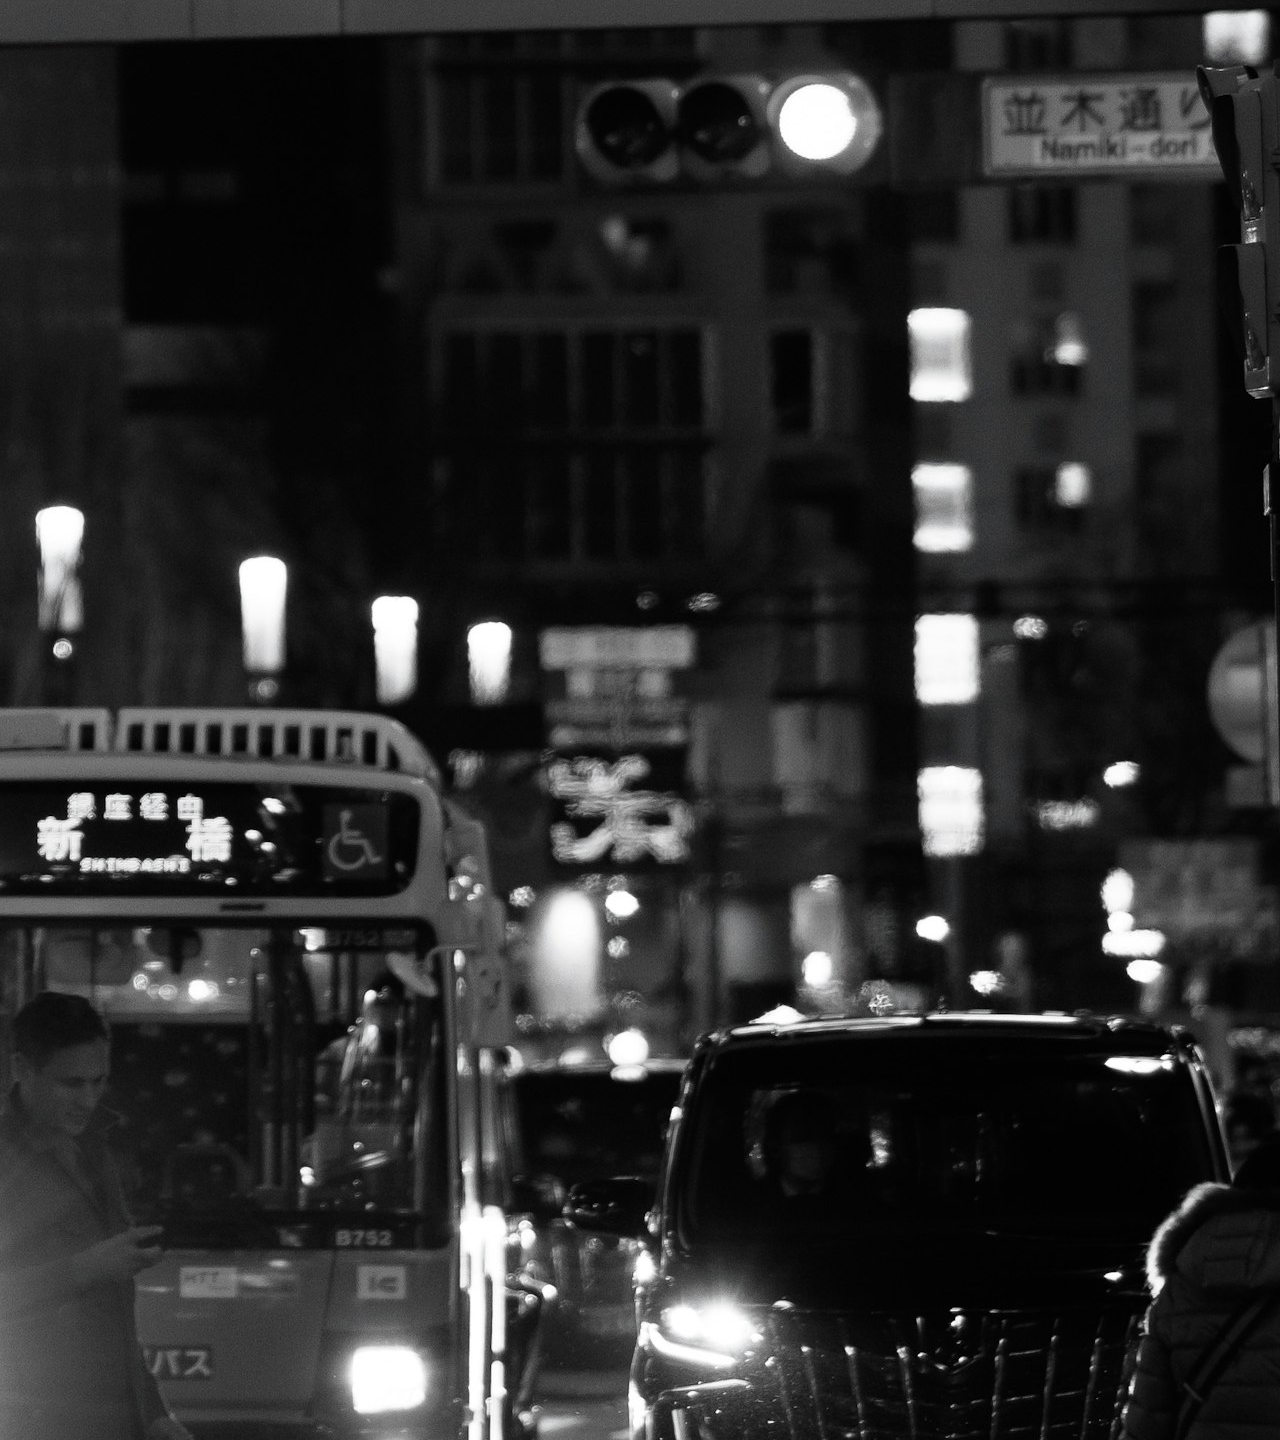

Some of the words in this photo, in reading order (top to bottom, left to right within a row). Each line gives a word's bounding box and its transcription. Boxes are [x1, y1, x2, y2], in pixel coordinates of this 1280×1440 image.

[1002, 87, 1212, 136] 並木通り
[1042, 132, 1198, 160] Namiki-dori
[335, 1228, 392, 1247] B752
[143, 1348, 211, 1376] バス
